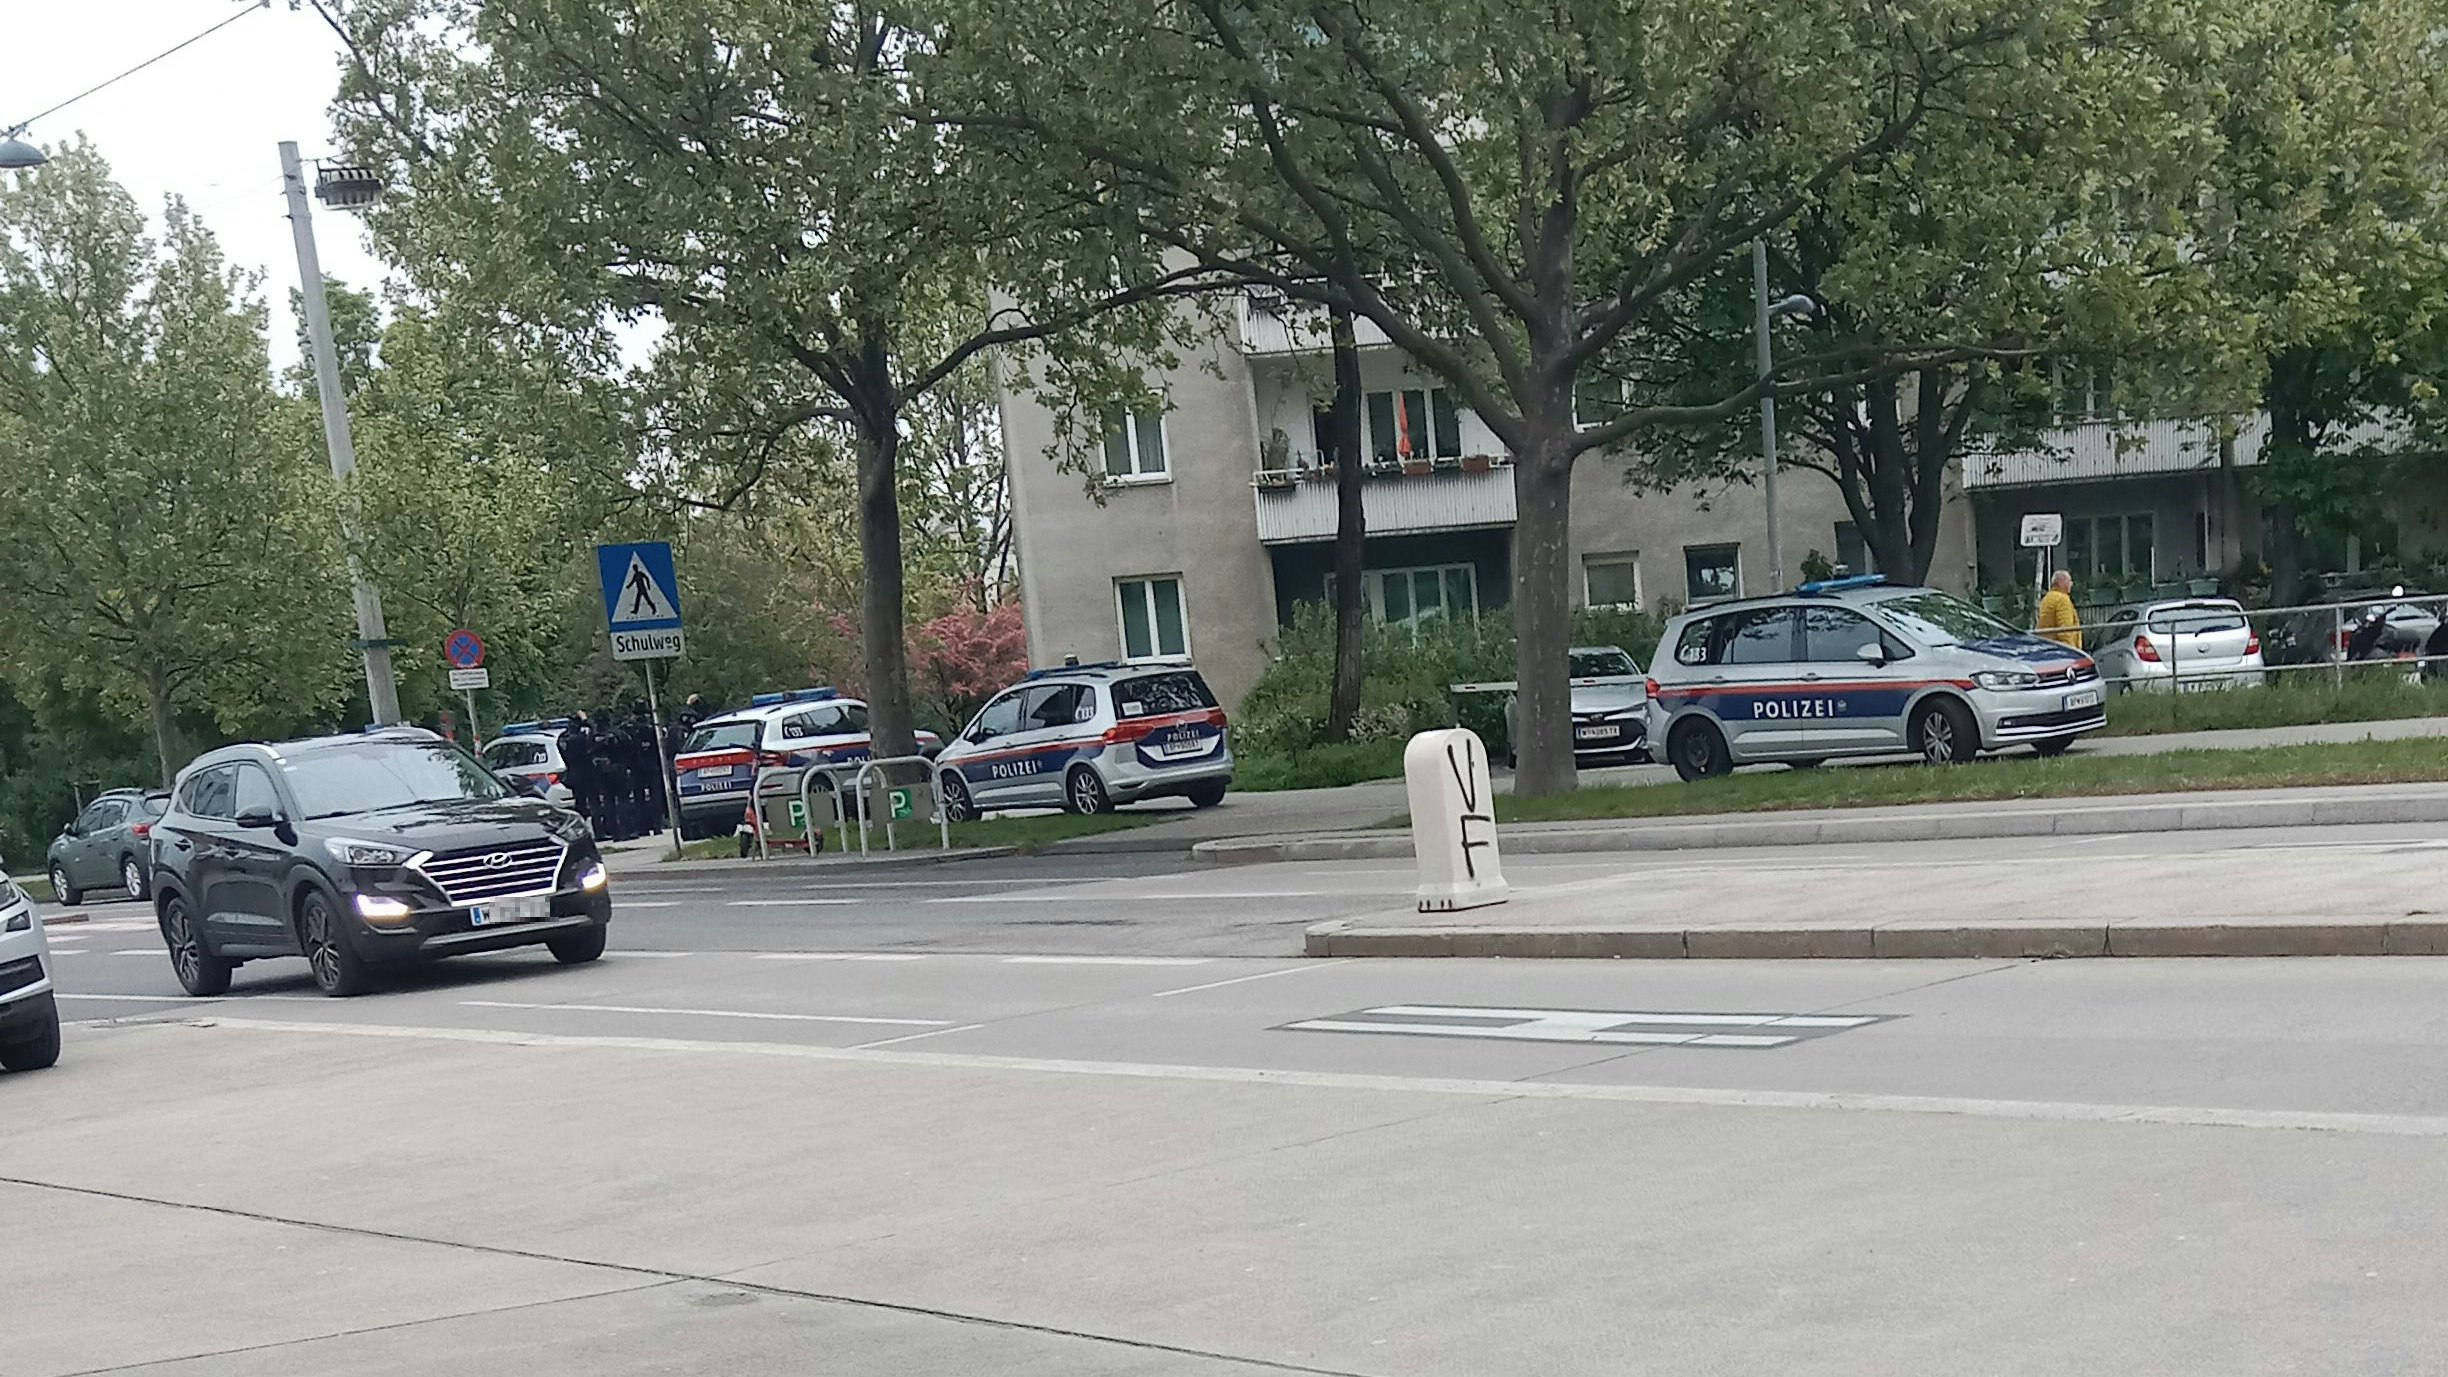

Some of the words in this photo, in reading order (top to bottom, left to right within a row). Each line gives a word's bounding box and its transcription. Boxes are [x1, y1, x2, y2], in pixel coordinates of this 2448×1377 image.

[616, 633, 681, 653] Schulweg
[1753, 699, 1834, 719] POLIZEI
[991, 760, 1038, 779] POLIZEI
